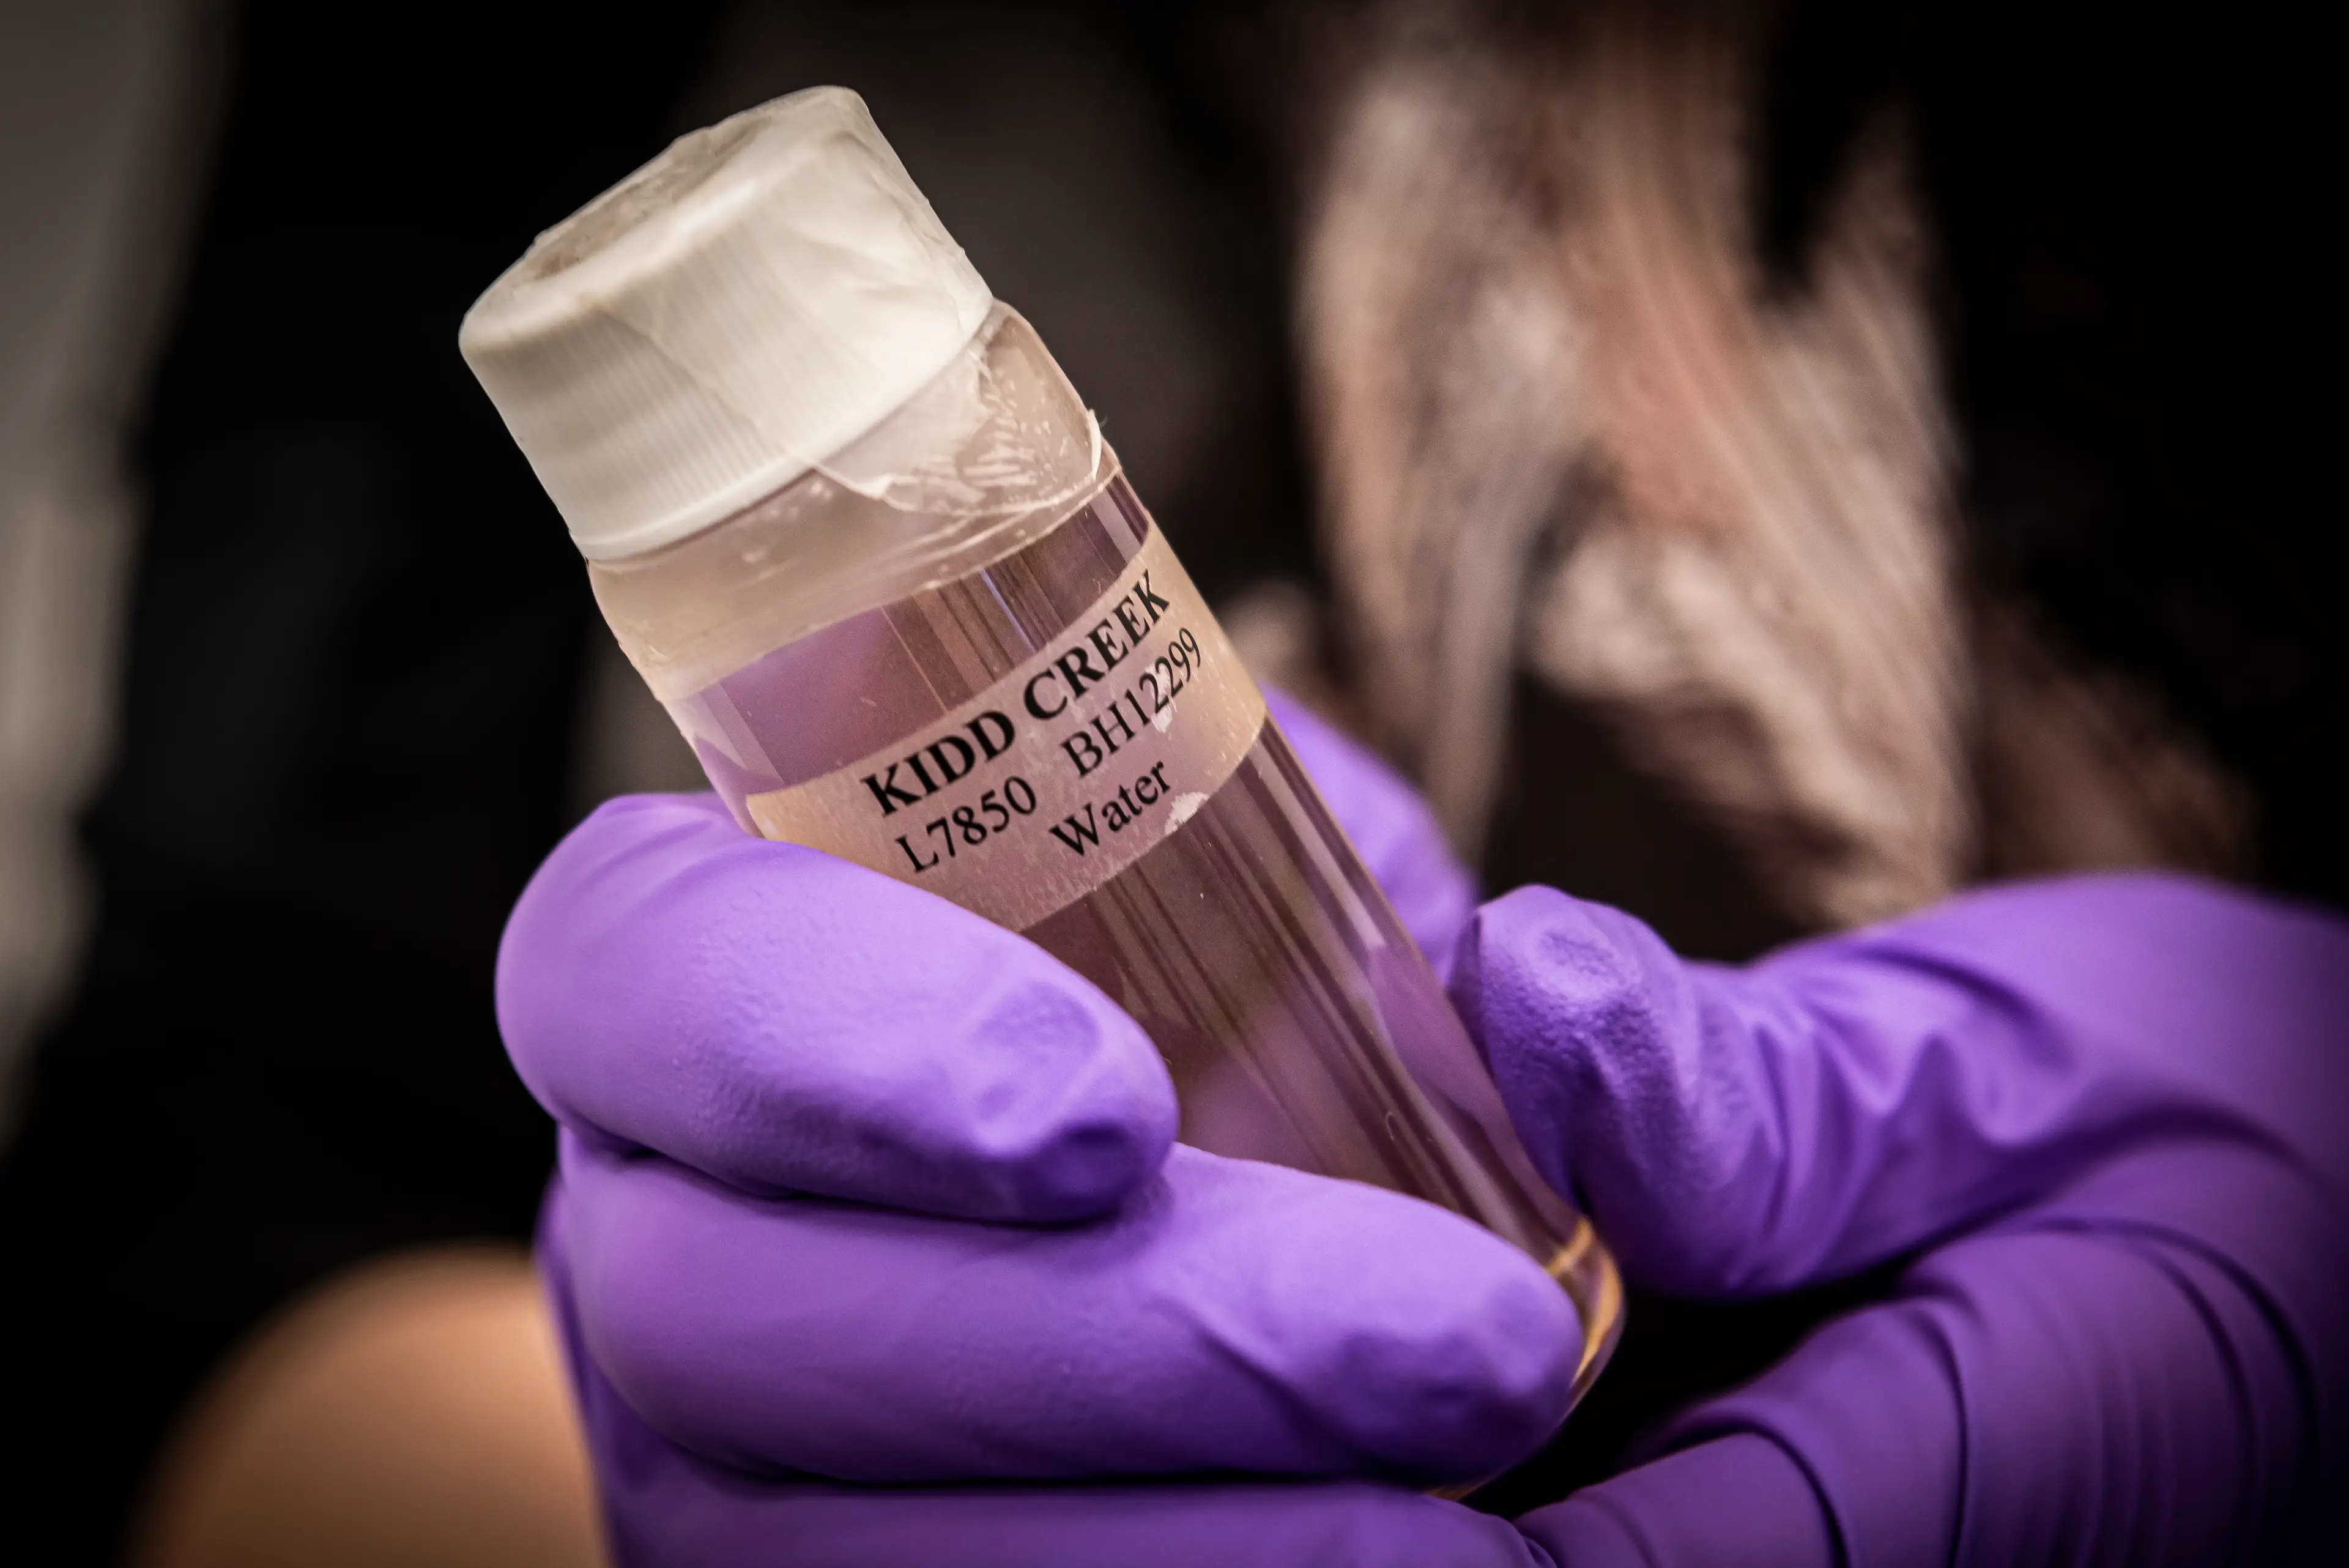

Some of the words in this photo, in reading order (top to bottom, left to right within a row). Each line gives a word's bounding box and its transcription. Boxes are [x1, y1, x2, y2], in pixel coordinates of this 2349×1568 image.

[860, 710, 1015, 817] KIDD
[1023, 569, 1170, 720] CREEK
[895, 776, 1036, 873] L7850
[1060, 627, 1201, 778] BH12299
[1049, 762, 1171, 856] Water
